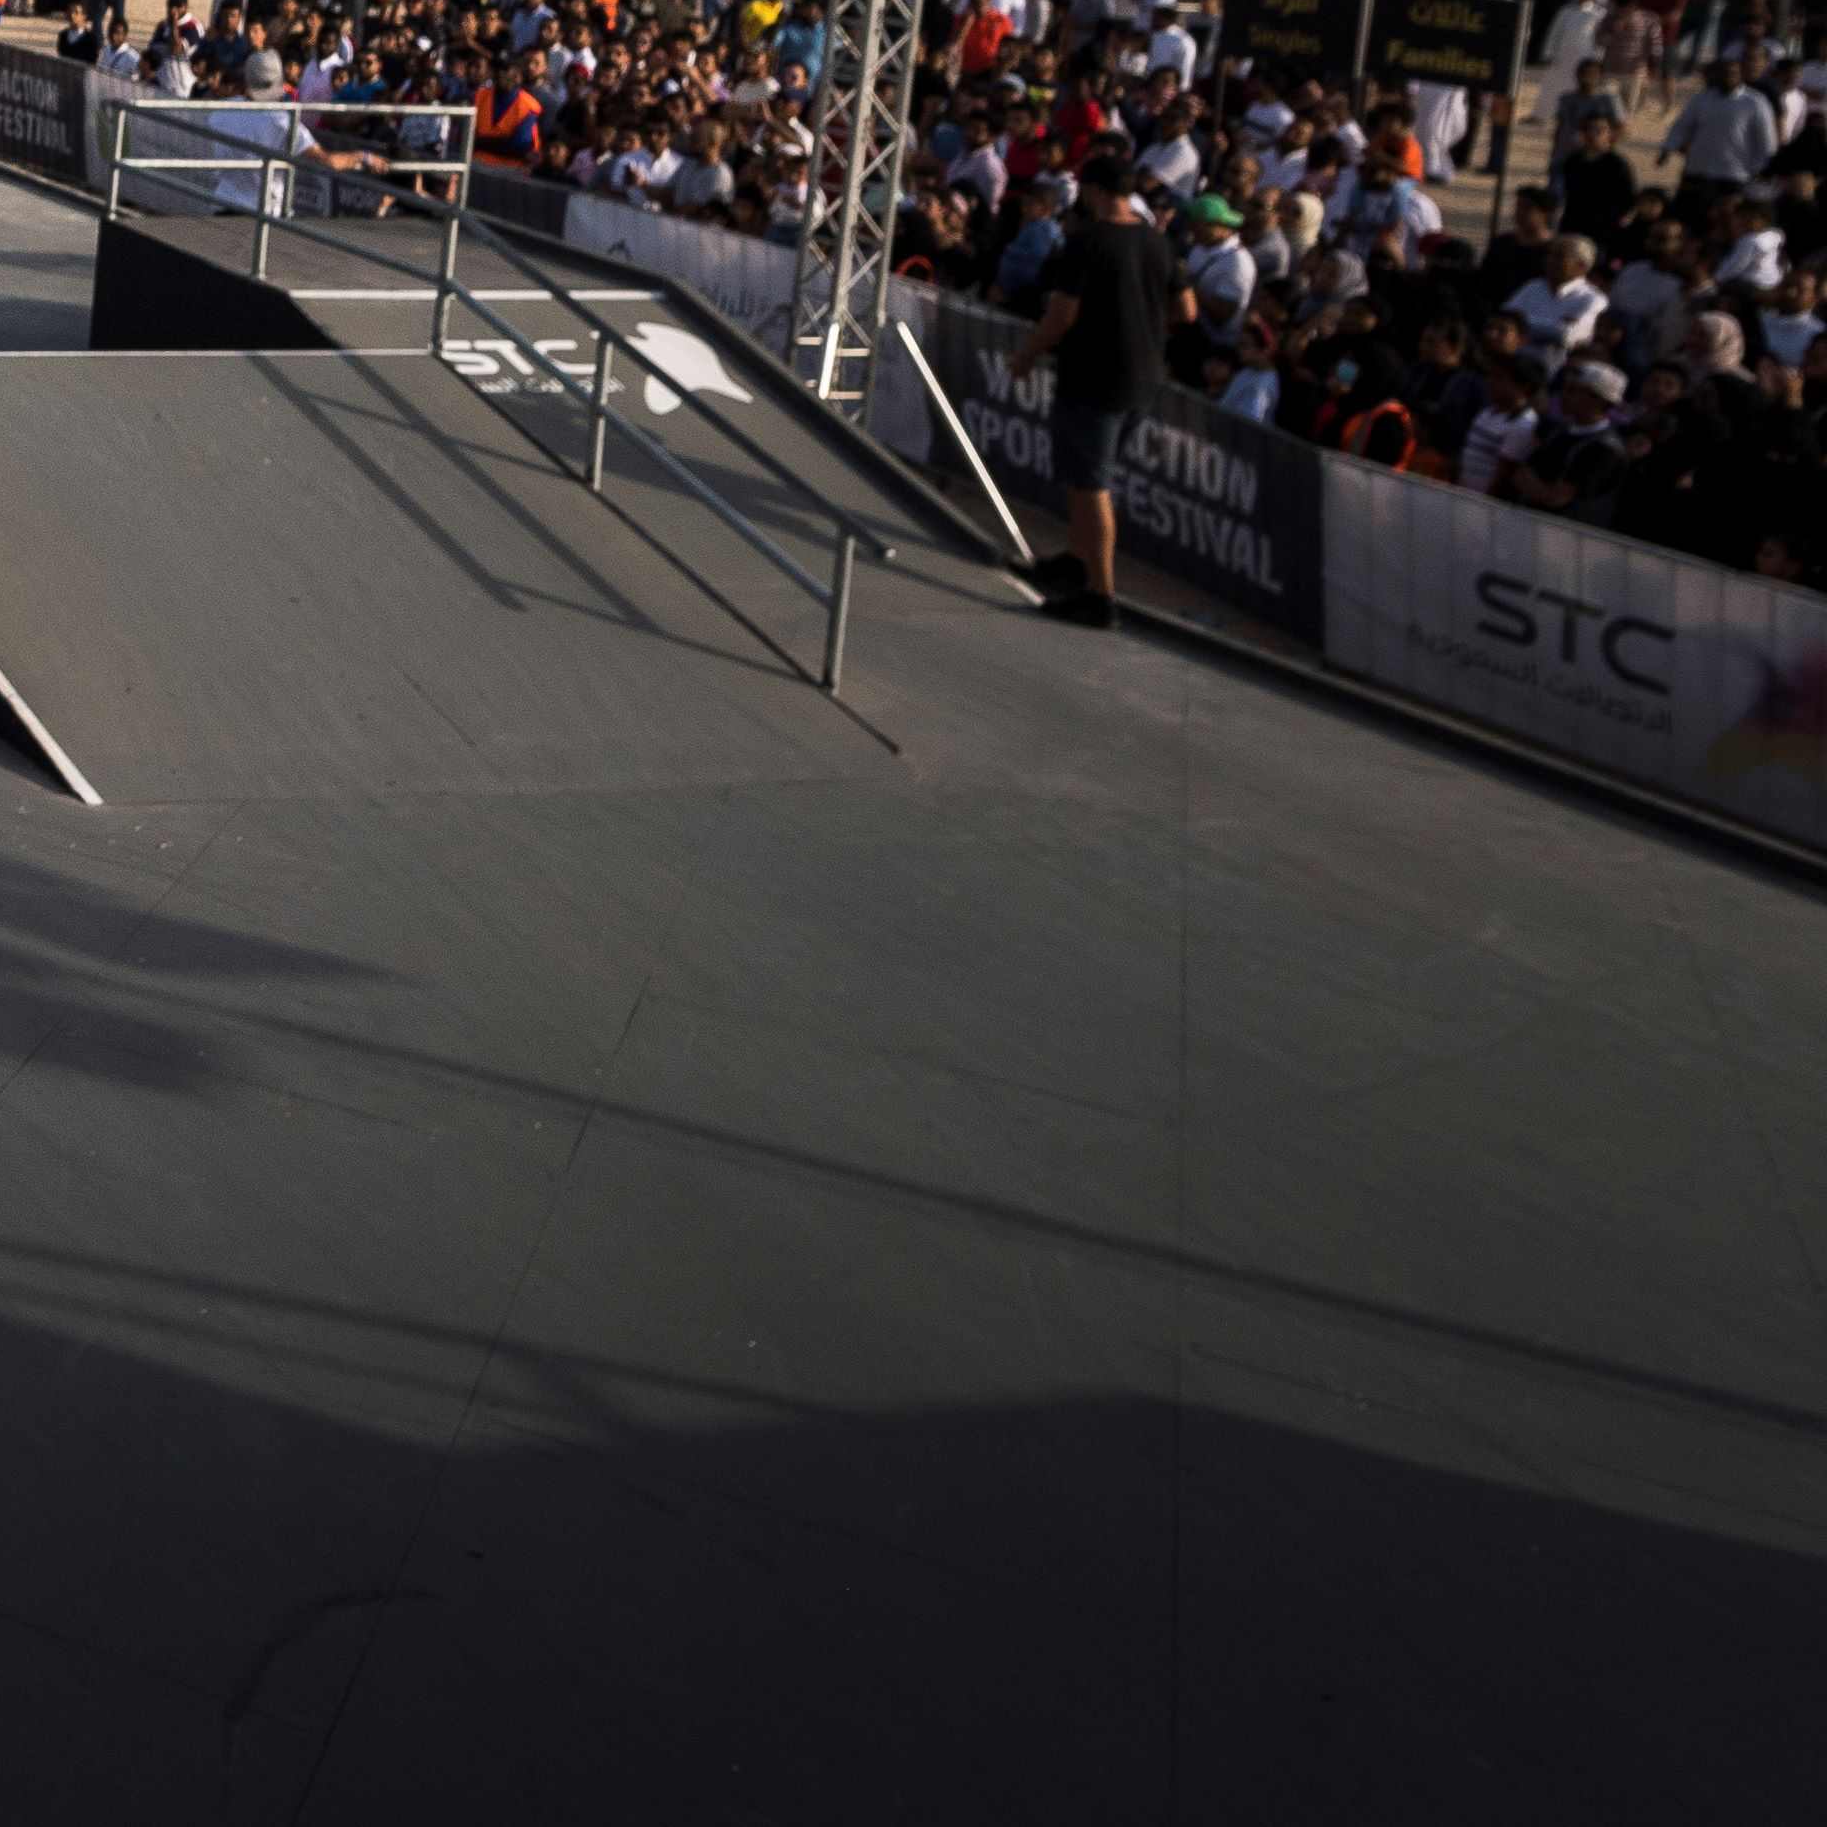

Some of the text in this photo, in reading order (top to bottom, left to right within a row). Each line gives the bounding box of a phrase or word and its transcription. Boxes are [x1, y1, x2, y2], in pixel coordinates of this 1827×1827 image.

[961, 398, 1055, 480] SPOR
[1123, 417, 1259, 517] CTION
[1476, 571, 1677, 697] STC
